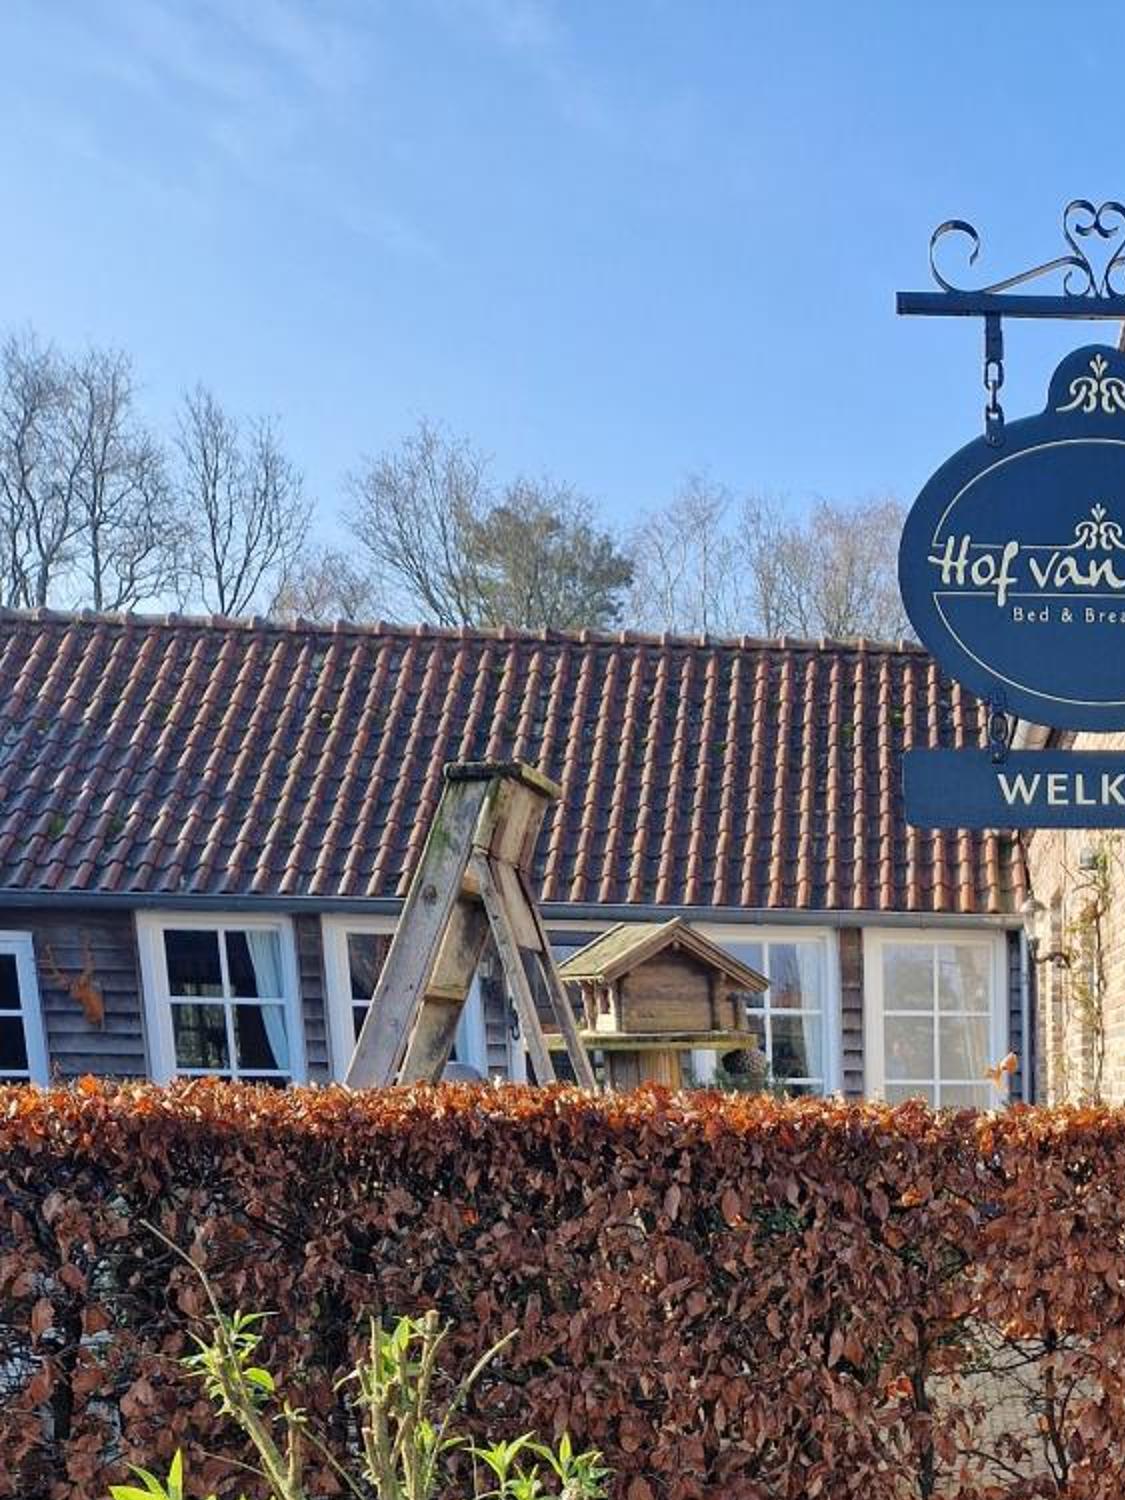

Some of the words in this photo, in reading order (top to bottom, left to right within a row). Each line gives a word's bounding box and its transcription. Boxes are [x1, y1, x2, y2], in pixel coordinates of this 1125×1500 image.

[928, 534, 1020, 607] Hof
[1012, 606, 1050, 623] Bed
[1060, 607, 1074, 623] &
